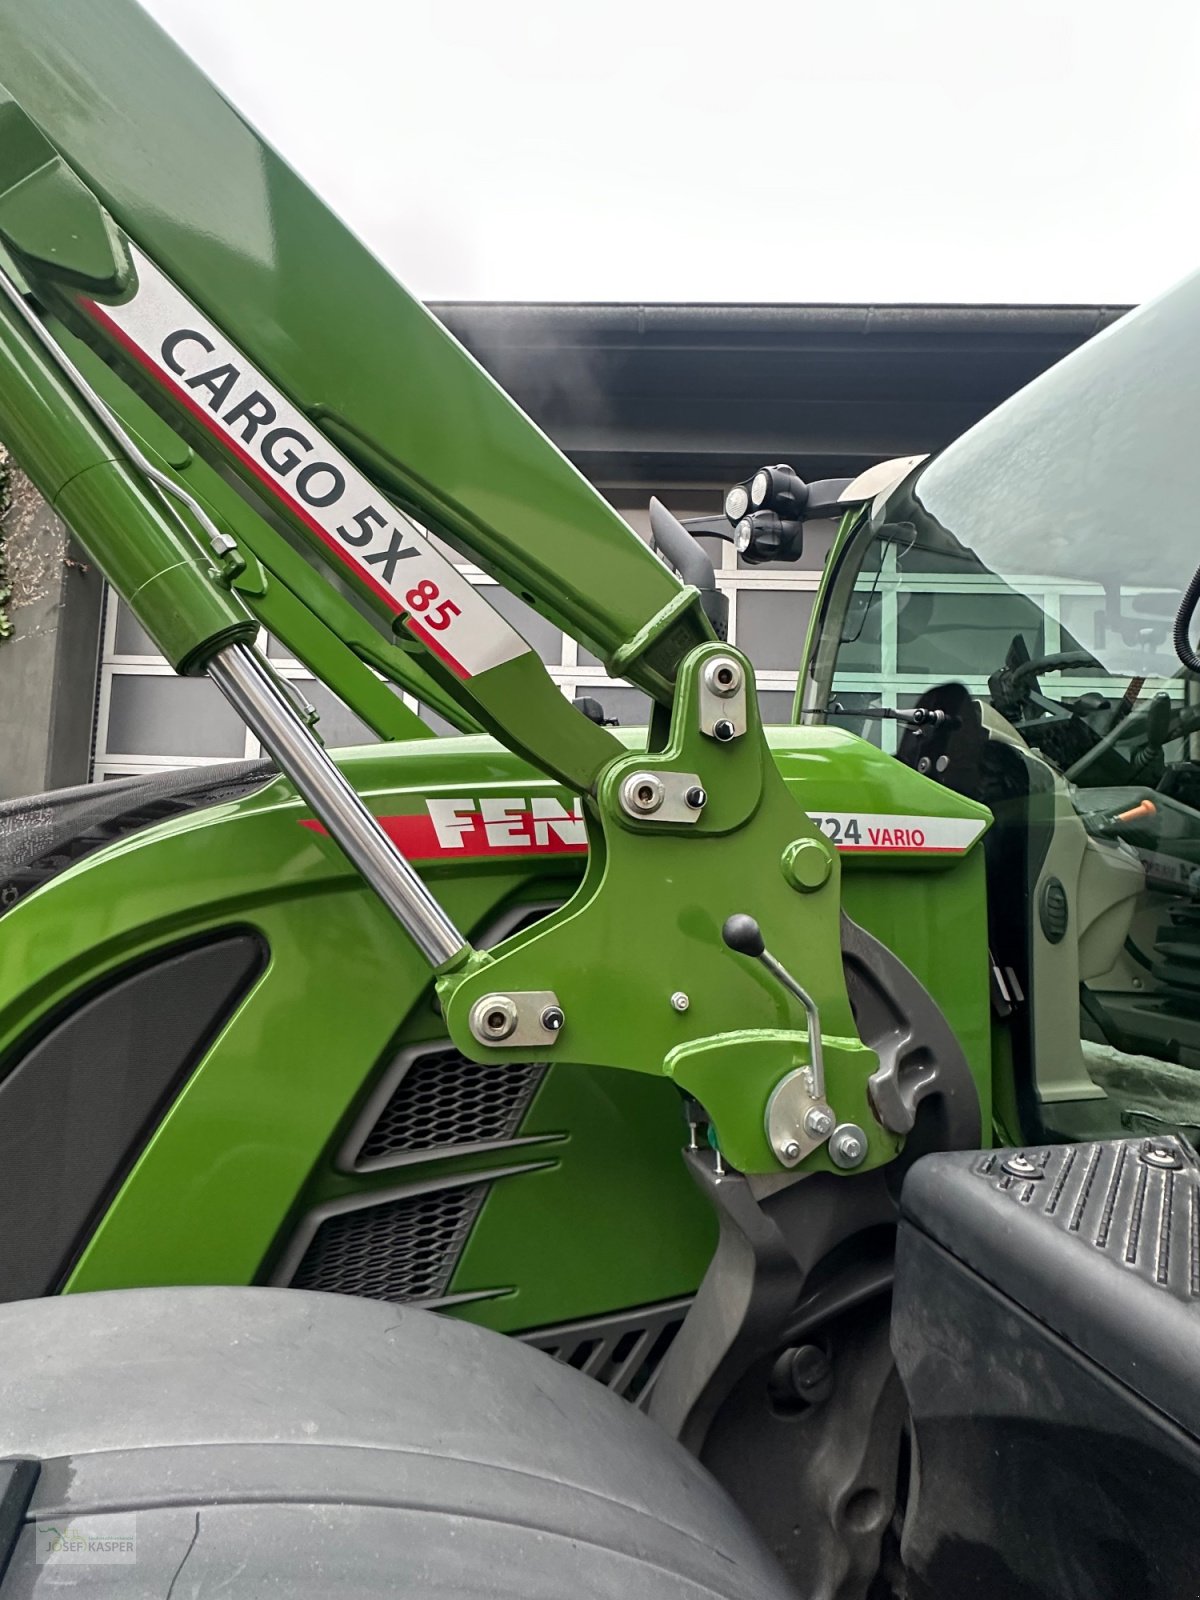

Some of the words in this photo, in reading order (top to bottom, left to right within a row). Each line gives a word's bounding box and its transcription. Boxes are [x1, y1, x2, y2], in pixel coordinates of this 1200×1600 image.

[160, 328, 347, 508] CARGO
[336, 505, 421, 585] 5X
[405, 579, 463, 631] 85
[868, 827, 925, 847] VARIO
